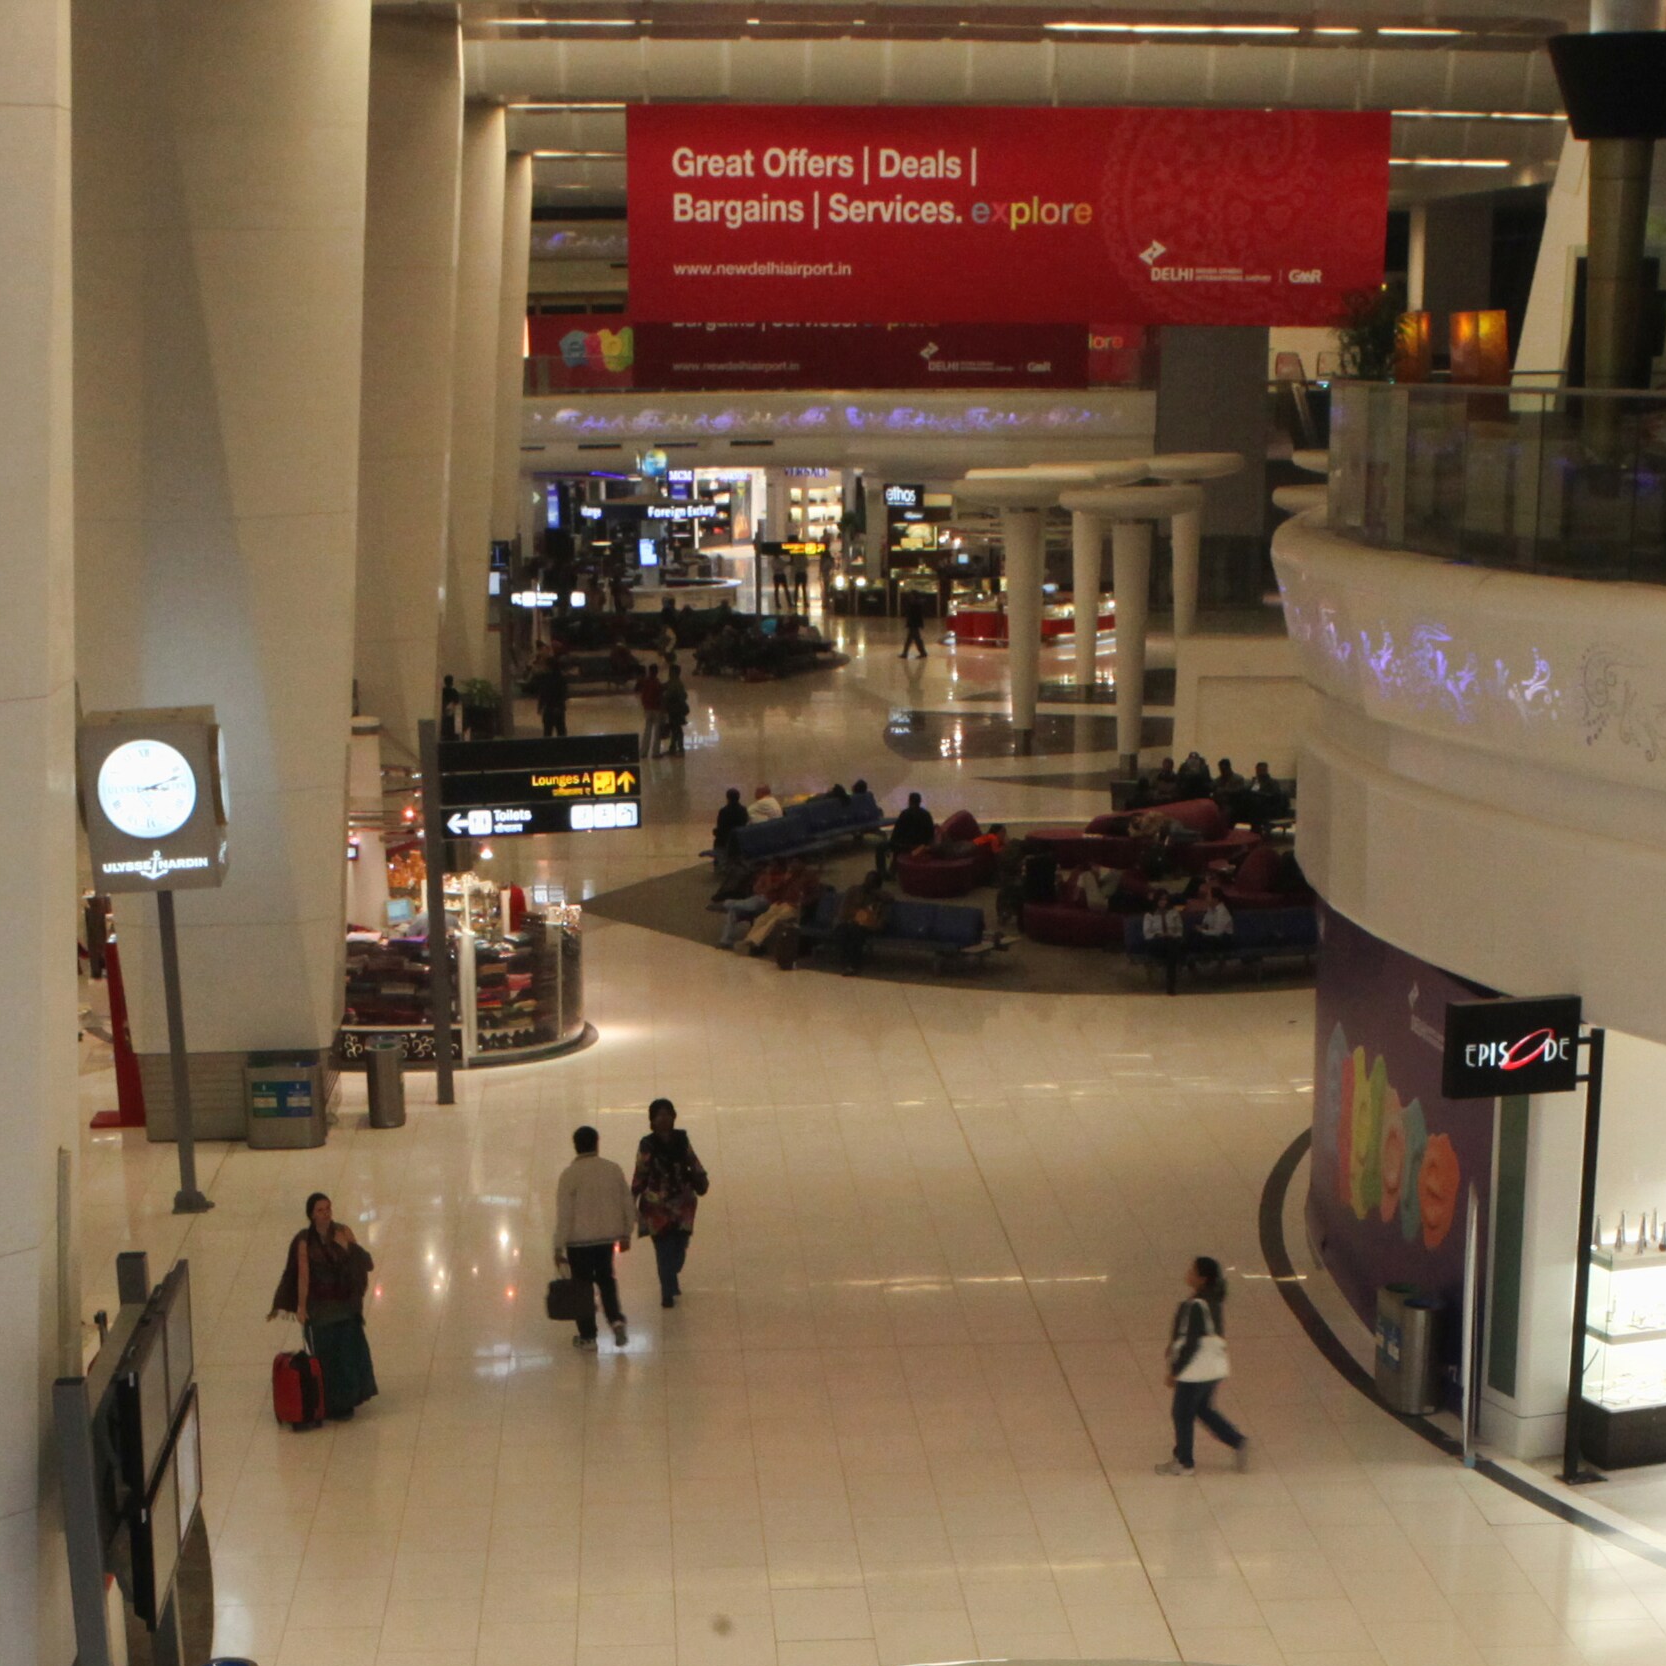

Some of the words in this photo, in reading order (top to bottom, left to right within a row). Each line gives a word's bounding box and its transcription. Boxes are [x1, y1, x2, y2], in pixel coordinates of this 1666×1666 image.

[672, 147, 755, 177] Great
[763, 147, 855, 178] Offers
[879, 148, 962, 179] Deals
[673, 192, 804, 229] Bargains
[828, 193, 962, 222] Services.
[971, 196, 1093, 231] explore
[673, 261, 851, 278] www.newdelhiairport.in
[1151, 267, 1194, 282] DELHI
[647, 505, 686, 519] Foreign
[531, 774, 580, 788] Lounges
[582, 772, 591, 784] A
[493, 808, 533, 822] Toilets
[102, 860, 152, 874] ULYSSE
[158, 856, 209, 871] NARDIN
[1465, 1028, 1571, 1071] EPISODE
